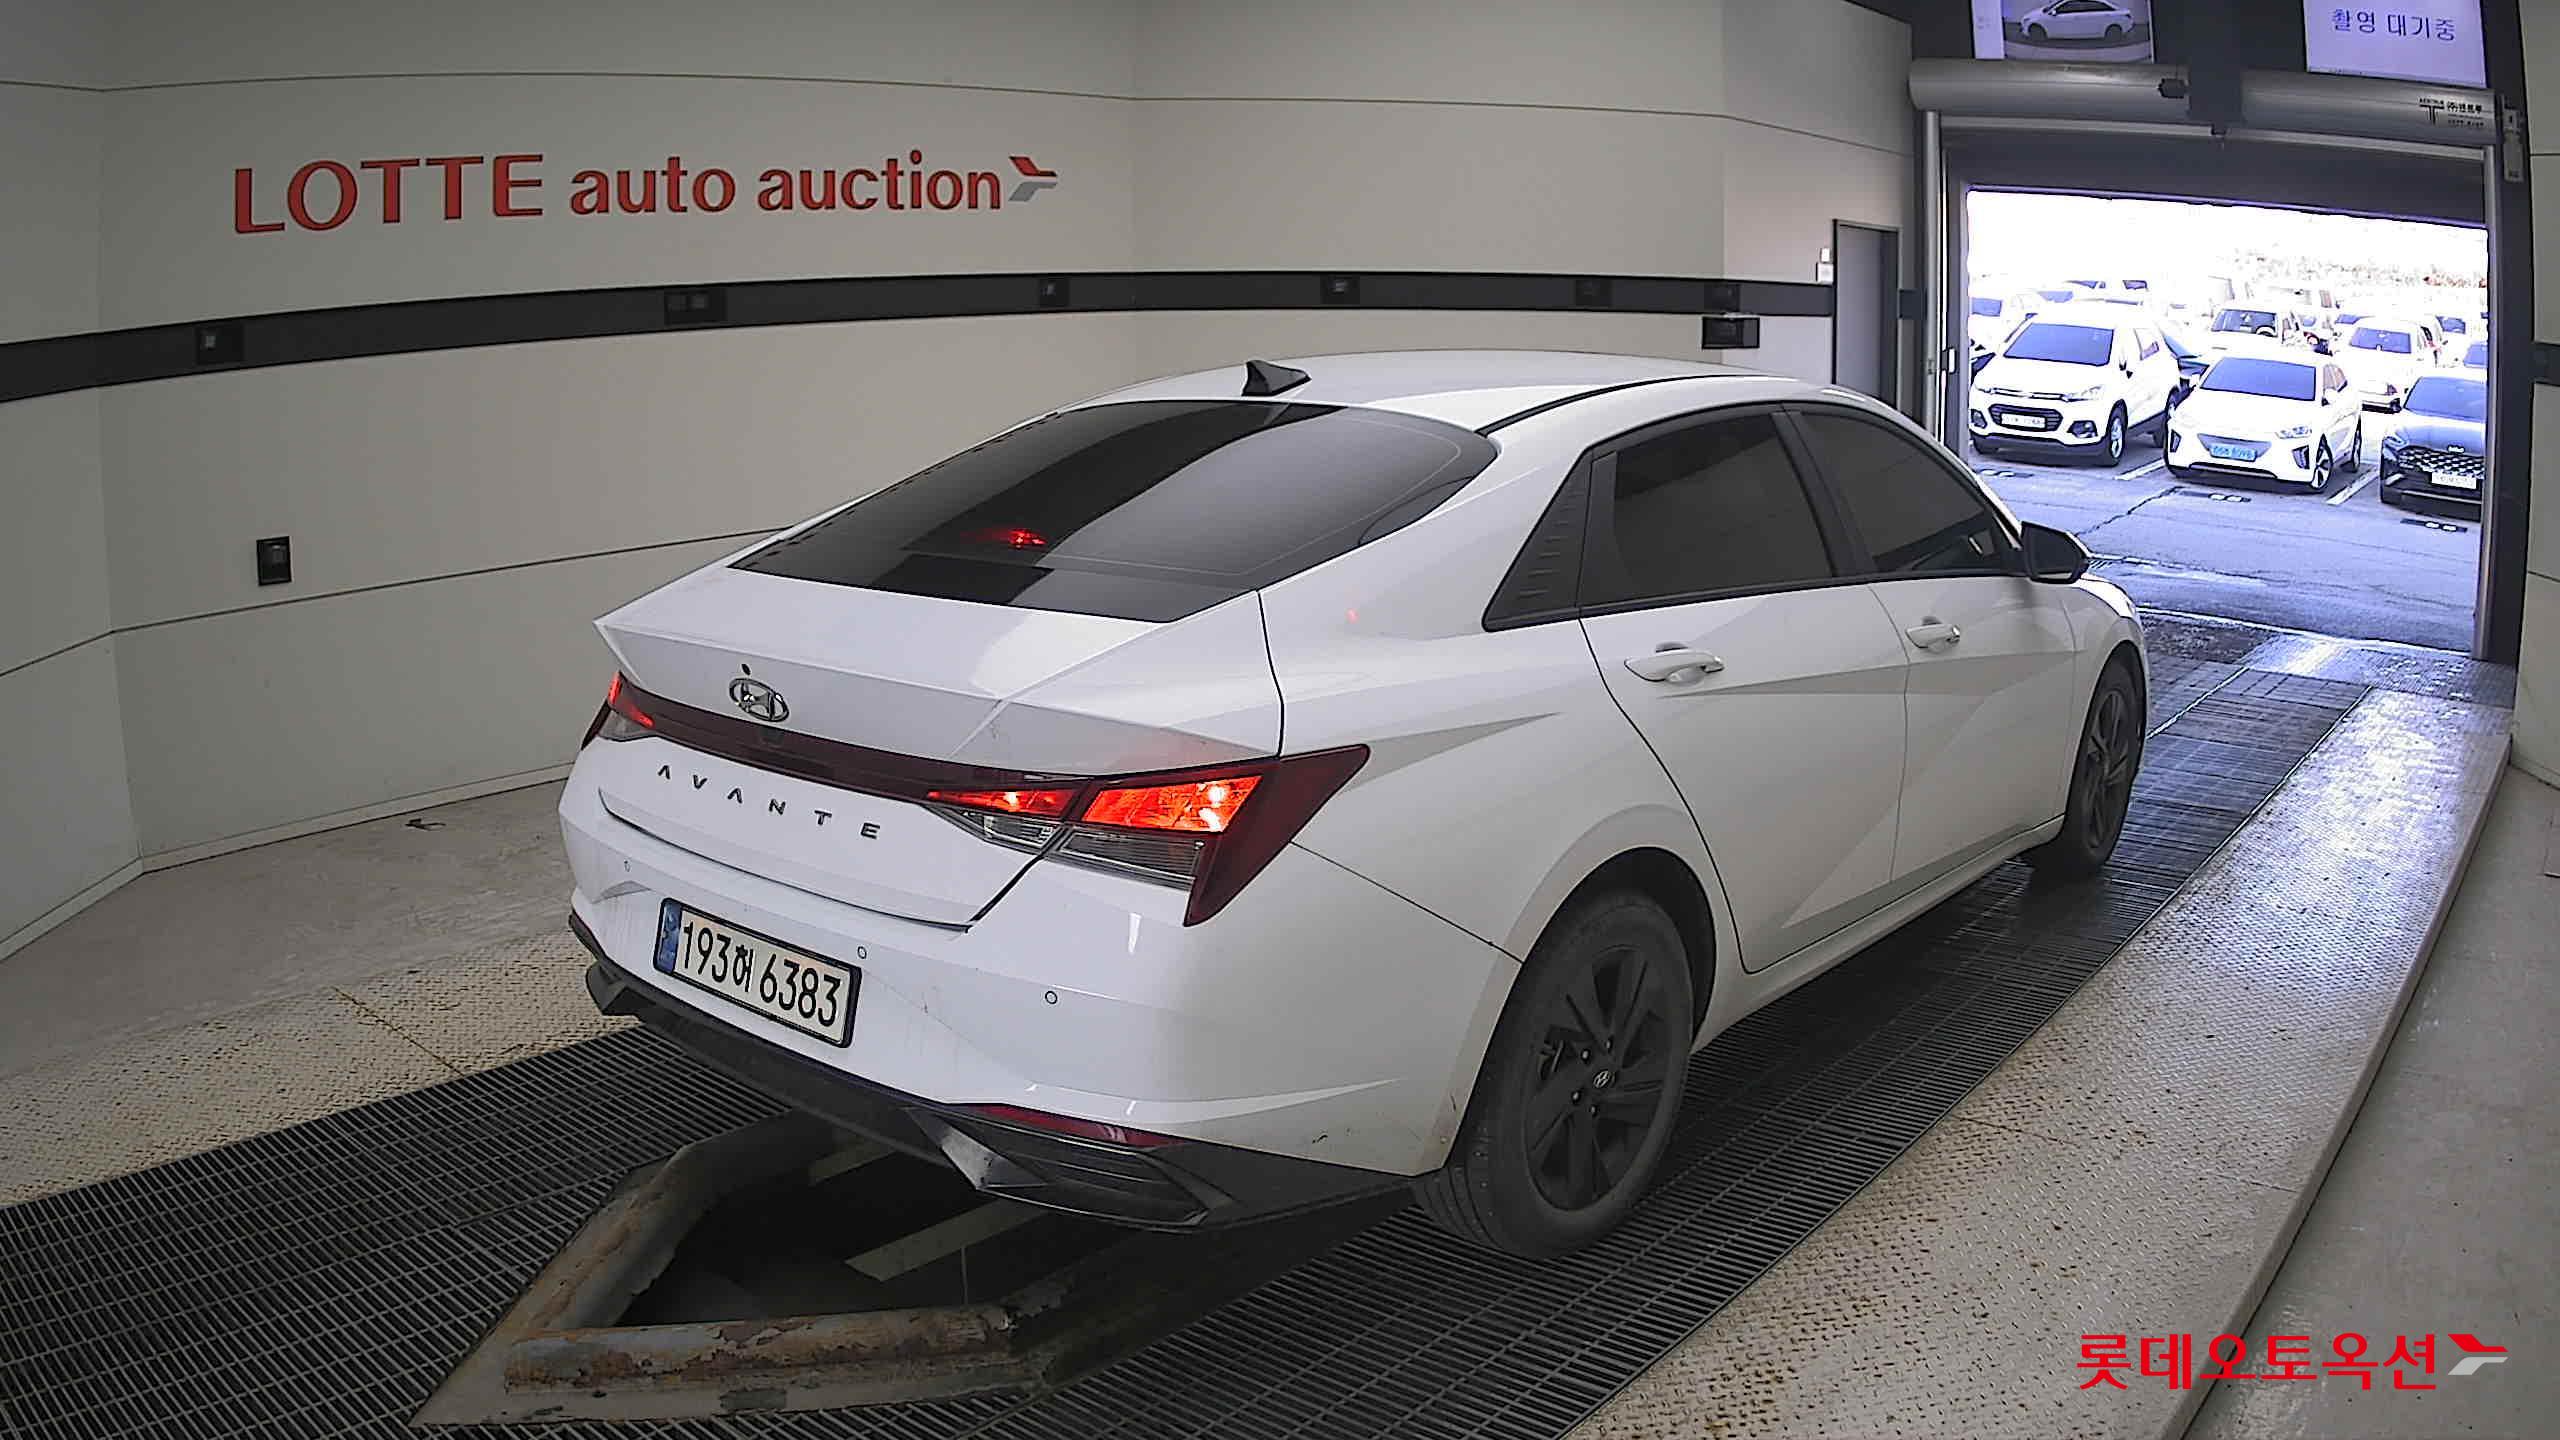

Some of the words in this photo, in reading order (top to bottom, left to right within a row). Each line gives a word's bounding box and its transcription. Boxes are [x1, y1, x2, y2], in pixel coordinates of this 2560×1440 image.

[2332, 8, 2376, 34] 촬영
[2387, 14, 2455, 41] 대기중
[234, 153, 544, 235] LOTTE
[569, 156, 736, 216] auto
[756, 149, 1001, 213] auction
[657, 764, 881, 840] AVANTE
